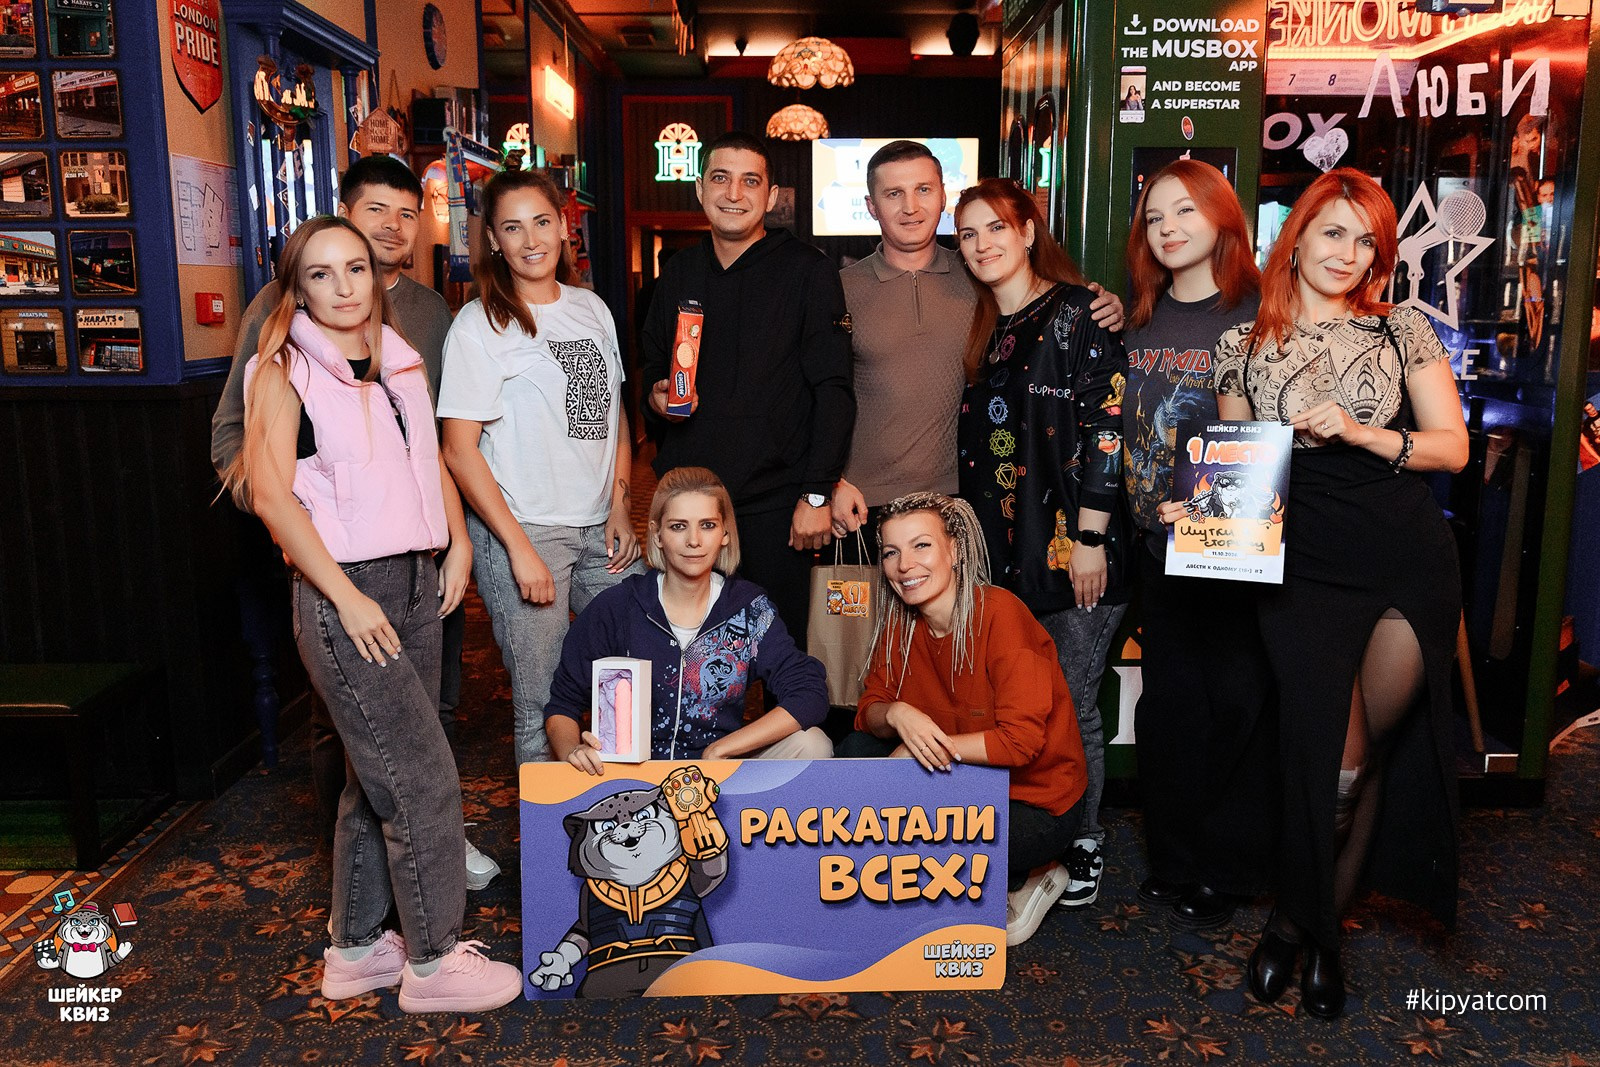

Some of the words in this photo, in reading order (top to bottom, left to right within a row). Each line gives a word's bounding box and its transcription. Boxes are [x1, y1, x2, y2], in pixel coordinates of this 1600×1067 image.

[173, 1, 217, 33] LONDON
[1153, 18, 1260, 33] DOWNLOAD
[175, 22, 219, 66] PRIDE
[1121, 47, 1148, 59] THE
[1152, 39, 1258, 59] MUSBOX
[1229, 61, 1258, 72] APP
[1152, 81, 1182, 92] AND
[1185, 80, 1241, 92] BECOME
[1287, 74, 1296, 86] 7
[1328, 74, 1337, 86] 8
[1151, 98, 1161, 109] A
[1164, 98, 1240, 110] SUPERSTAR
[370, 119, 389, 128] HOME
[370, 135, 390, 144] HOME
[84, 315, 117, 323] HARAT'S
[1206, 424, 1238, 433] ШЕЙКЕР
[1187, 437, 1204, 464] 1
[1204, 441, 1277, 465] МЕСТО
[740, 805, 996, 848] РАСКАТАЛИ
[818, 853, 990, 904] ВСЕХ!
[922, 940, 997, 962] ШЕЙКЕР
[933, 960, 985, 979] КВИЗ
